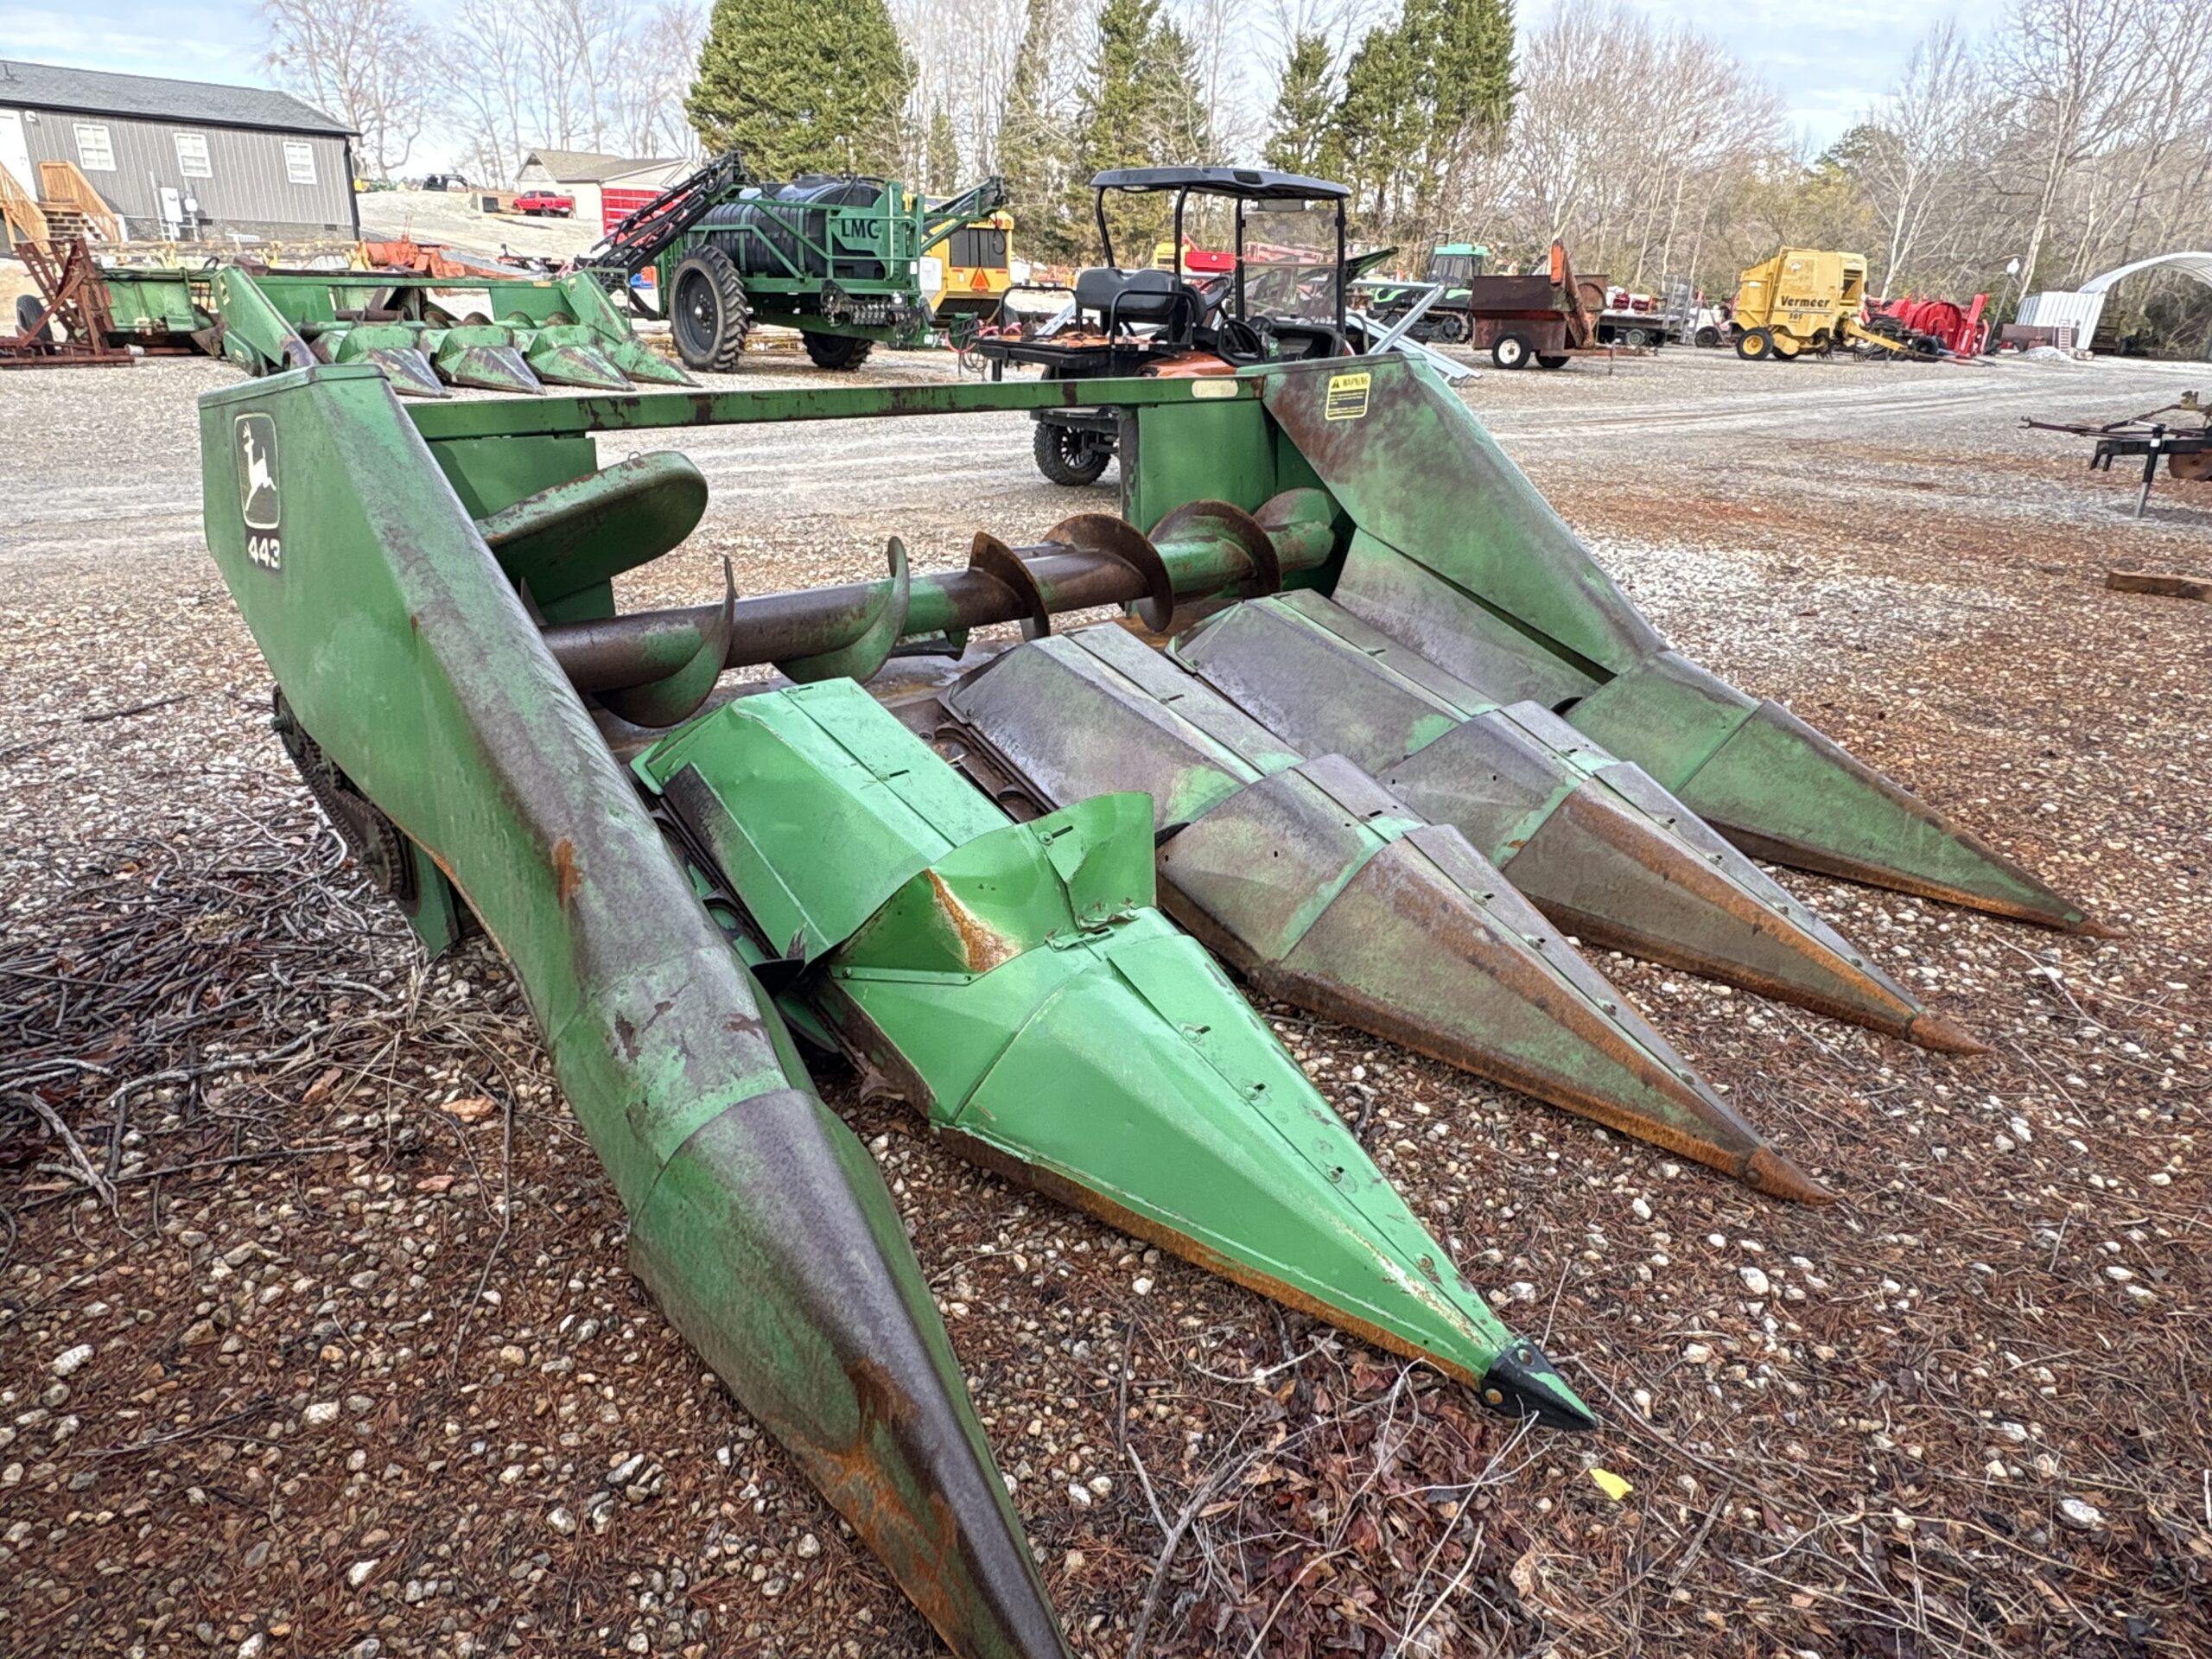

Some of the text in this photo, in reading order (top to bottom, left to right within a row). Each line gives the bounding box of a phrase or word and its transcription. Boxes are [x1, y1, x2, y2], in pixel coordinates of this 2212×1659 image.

[842, 219, 880, 239] LMC
[1781, 296, 1831, 308] Vermeer
[248, 536, 281, 570] 443
